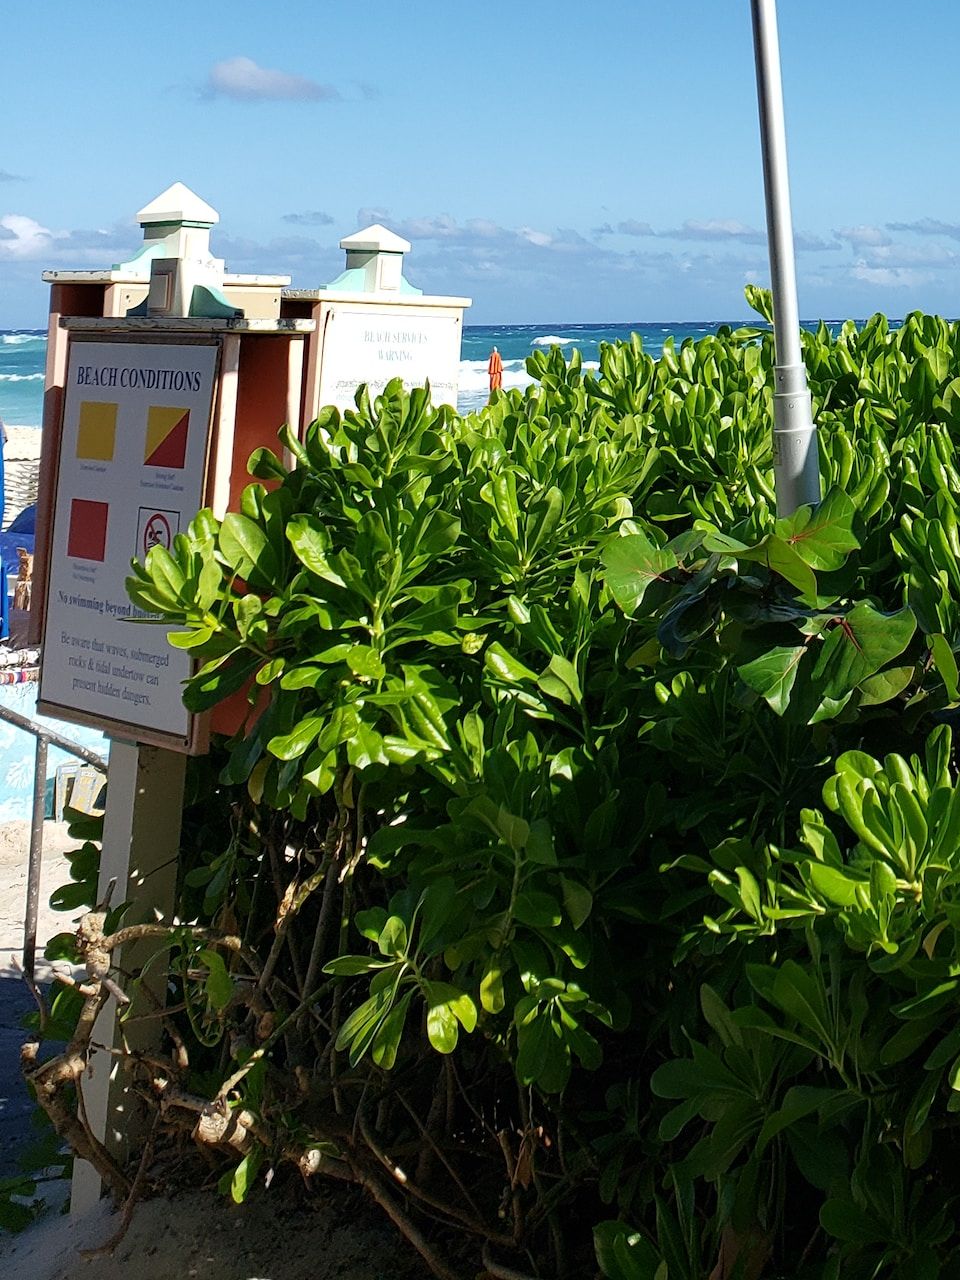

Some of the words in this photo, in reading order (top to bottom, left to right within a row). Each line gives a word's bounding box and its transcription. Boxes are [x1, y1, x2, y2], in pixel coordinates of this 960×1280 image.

[364, 330, 392, 343] BEACH
[393, 331, 428, 344] SERVICES
[378, 349, 413, 362] WARNING
[76, 366, 118, 387] BEACH
[120, 368, 202, 392] CONDITIONS
[57, 590, 68, 604] No
[69, 594, 104, 614] swimming
[105, 600, 131, 617] beyond
[61, 631, 70, 644] Be
[71, 637, 91, 649] aware
[91, 639, 104, 652] that
[105, 645, 129, 659] waves,
[130, 648, 169, 668] submerged
[87, 658, 94, 670] &
[95, 660, 111, 674] tidal
[112, 665, 145, 682] undertow
[146, 675, 159, 686] can
[72, 678, 96, 690] present
[97, 680, 120, 698] hidden
[121, 686, 151, 706] dangers.
